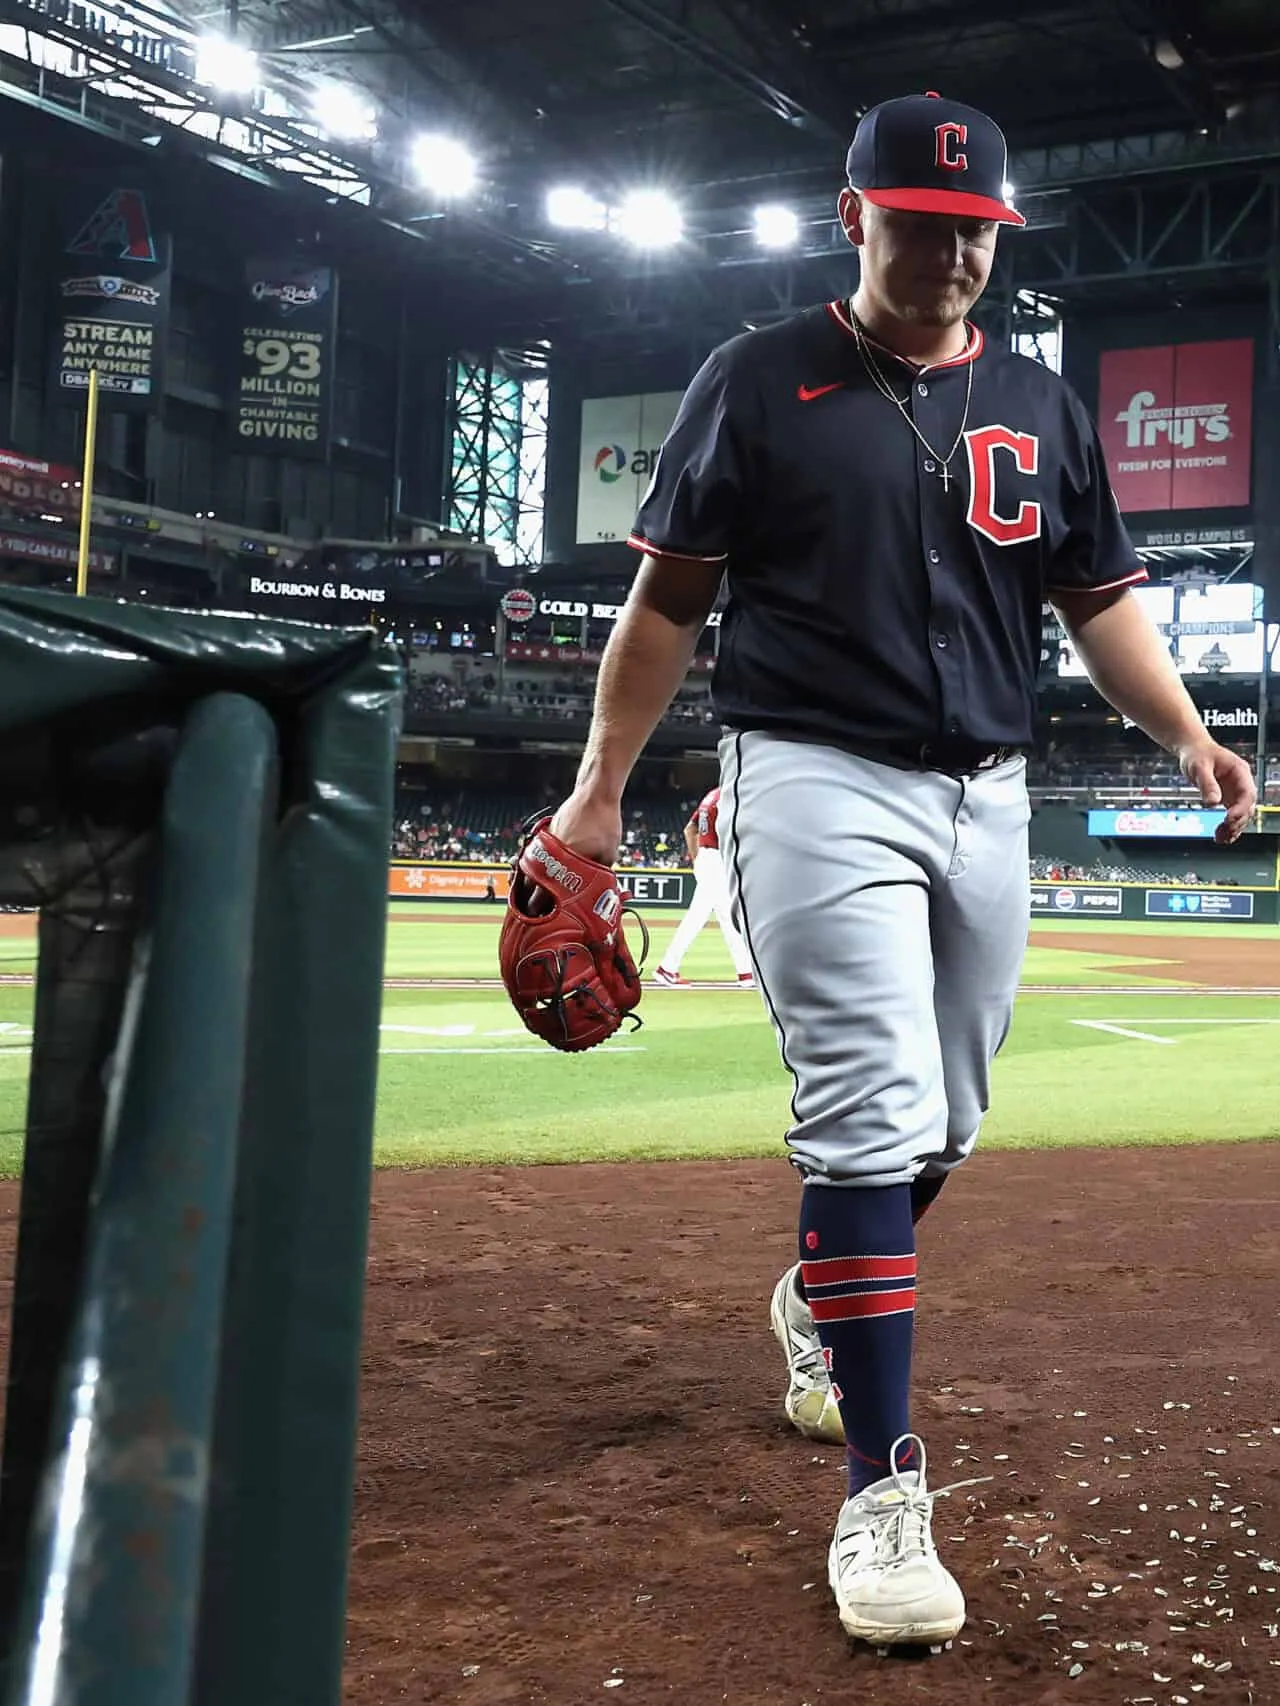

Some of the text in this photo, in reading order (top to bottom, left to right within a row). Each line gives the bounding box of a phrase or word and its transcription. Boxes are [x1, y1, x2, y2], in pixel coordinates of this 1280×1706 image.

[934, 122, 967, 172] C
[63, 322, 153, 346] STREAM
[62, 341, 151, 361] ANY GAME
[242, 338, 321, 380] $93
[62, 355, 151, 376] ANYWHERE
[240, 377, 320, 397] MILLION
[239, 407, 320, 423] CHARITABLE
[1114, 390, 1231, 449] fry's
[238, 419, 319, 441] GIVING
[1118, 456, 1227, 473] FRESH FOR EVERYONE
[962, 423, 1041, 547] C
[322, 583, 337, 598] &
[539, 600, 589, 617] COLD
[1203, 707, 1259, 727] Health
